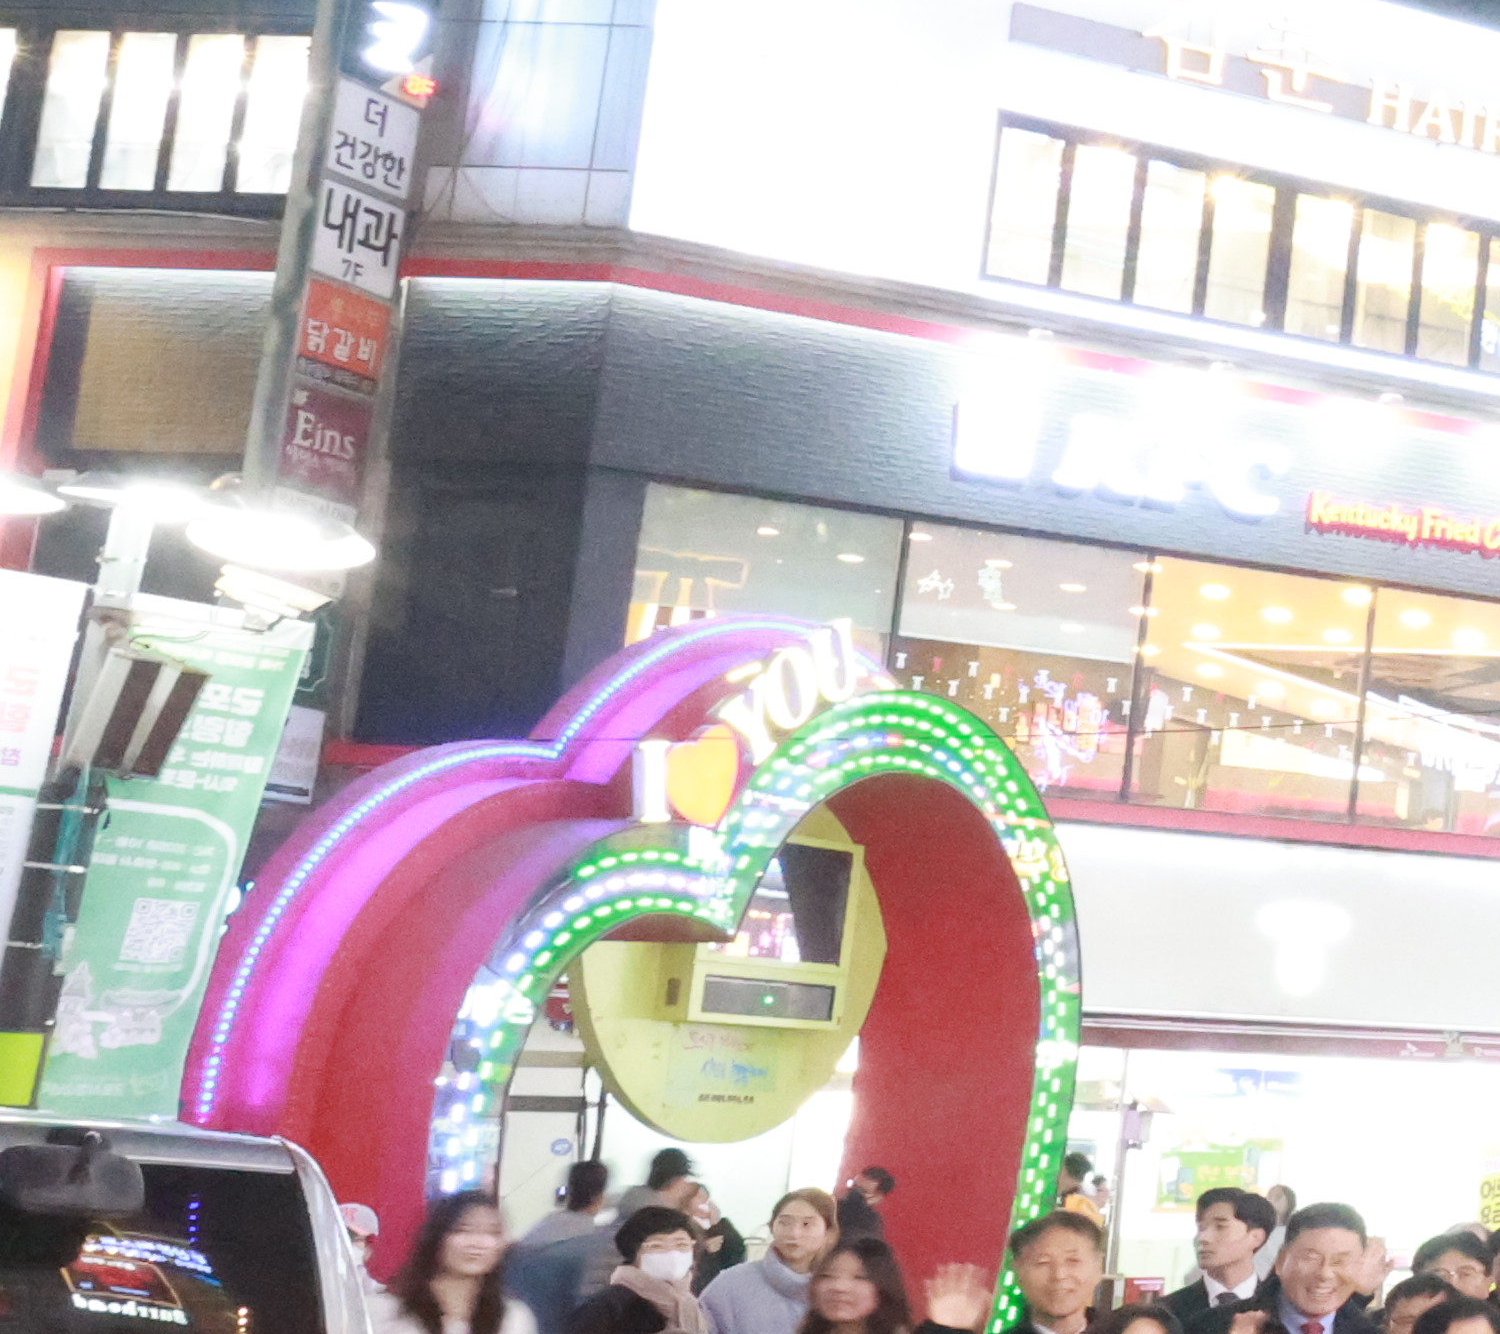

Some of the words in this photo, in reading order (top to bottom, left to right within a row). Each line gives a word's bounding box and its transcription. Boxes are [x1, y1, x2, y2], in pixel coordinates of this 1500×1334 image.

[364, 97, 390, 137] 더
[334, 131, 406, 190] 건강한
[321, 188, 400, 269] 내과
[342, 257, 364, 281] 7F
[306, 318, 377, 369] 닭갈비
[293, 409, 356, 460] Eins
[1308, 492, 1419, 543] Kentucky
[1420, 508, 1482, 545] Fried
[718, 618, 856, 766] YOU
